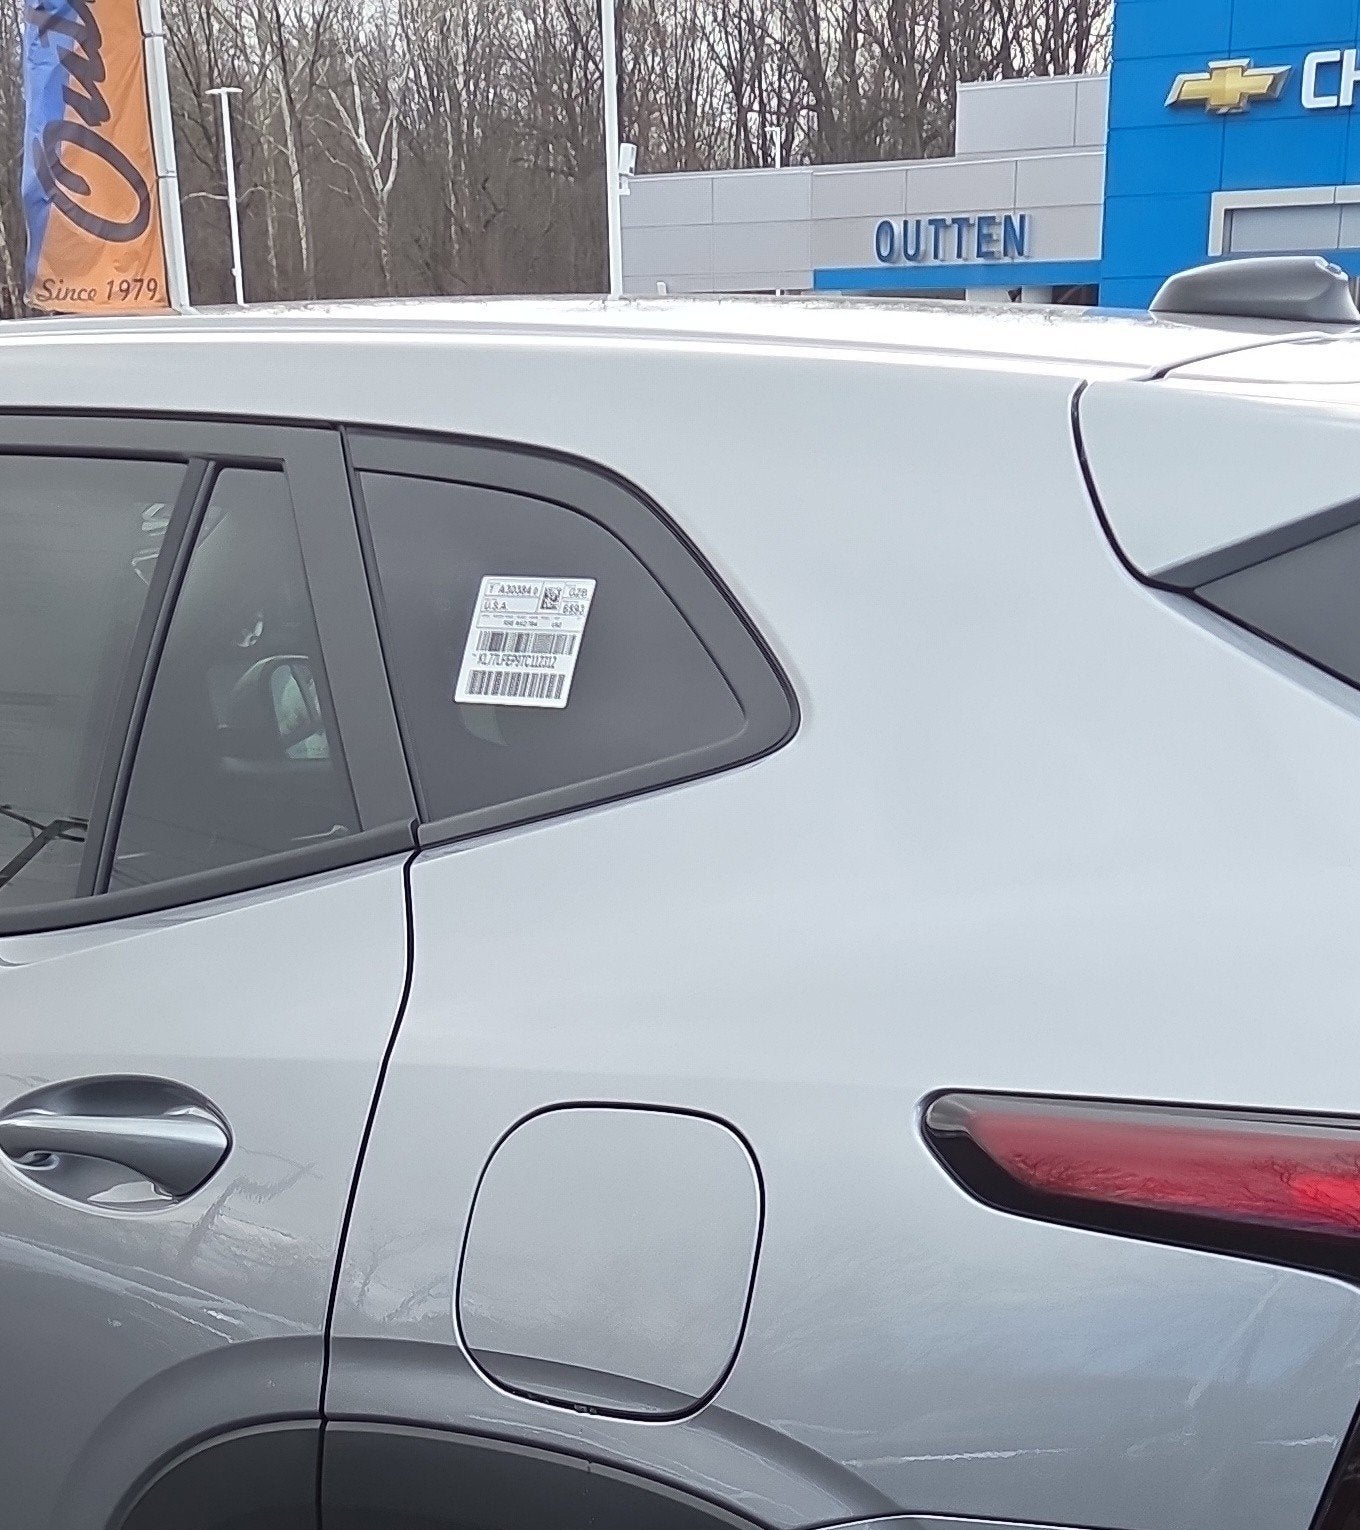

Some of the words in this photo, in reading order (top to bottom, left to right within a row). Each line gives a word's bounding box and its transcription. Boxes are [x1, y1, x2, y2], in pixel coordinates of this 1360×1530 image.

[875, 213, 1027, 263] OUTTEN
[36, 278, 97, 302] Since
[106, 277, 159, 301] 1979
